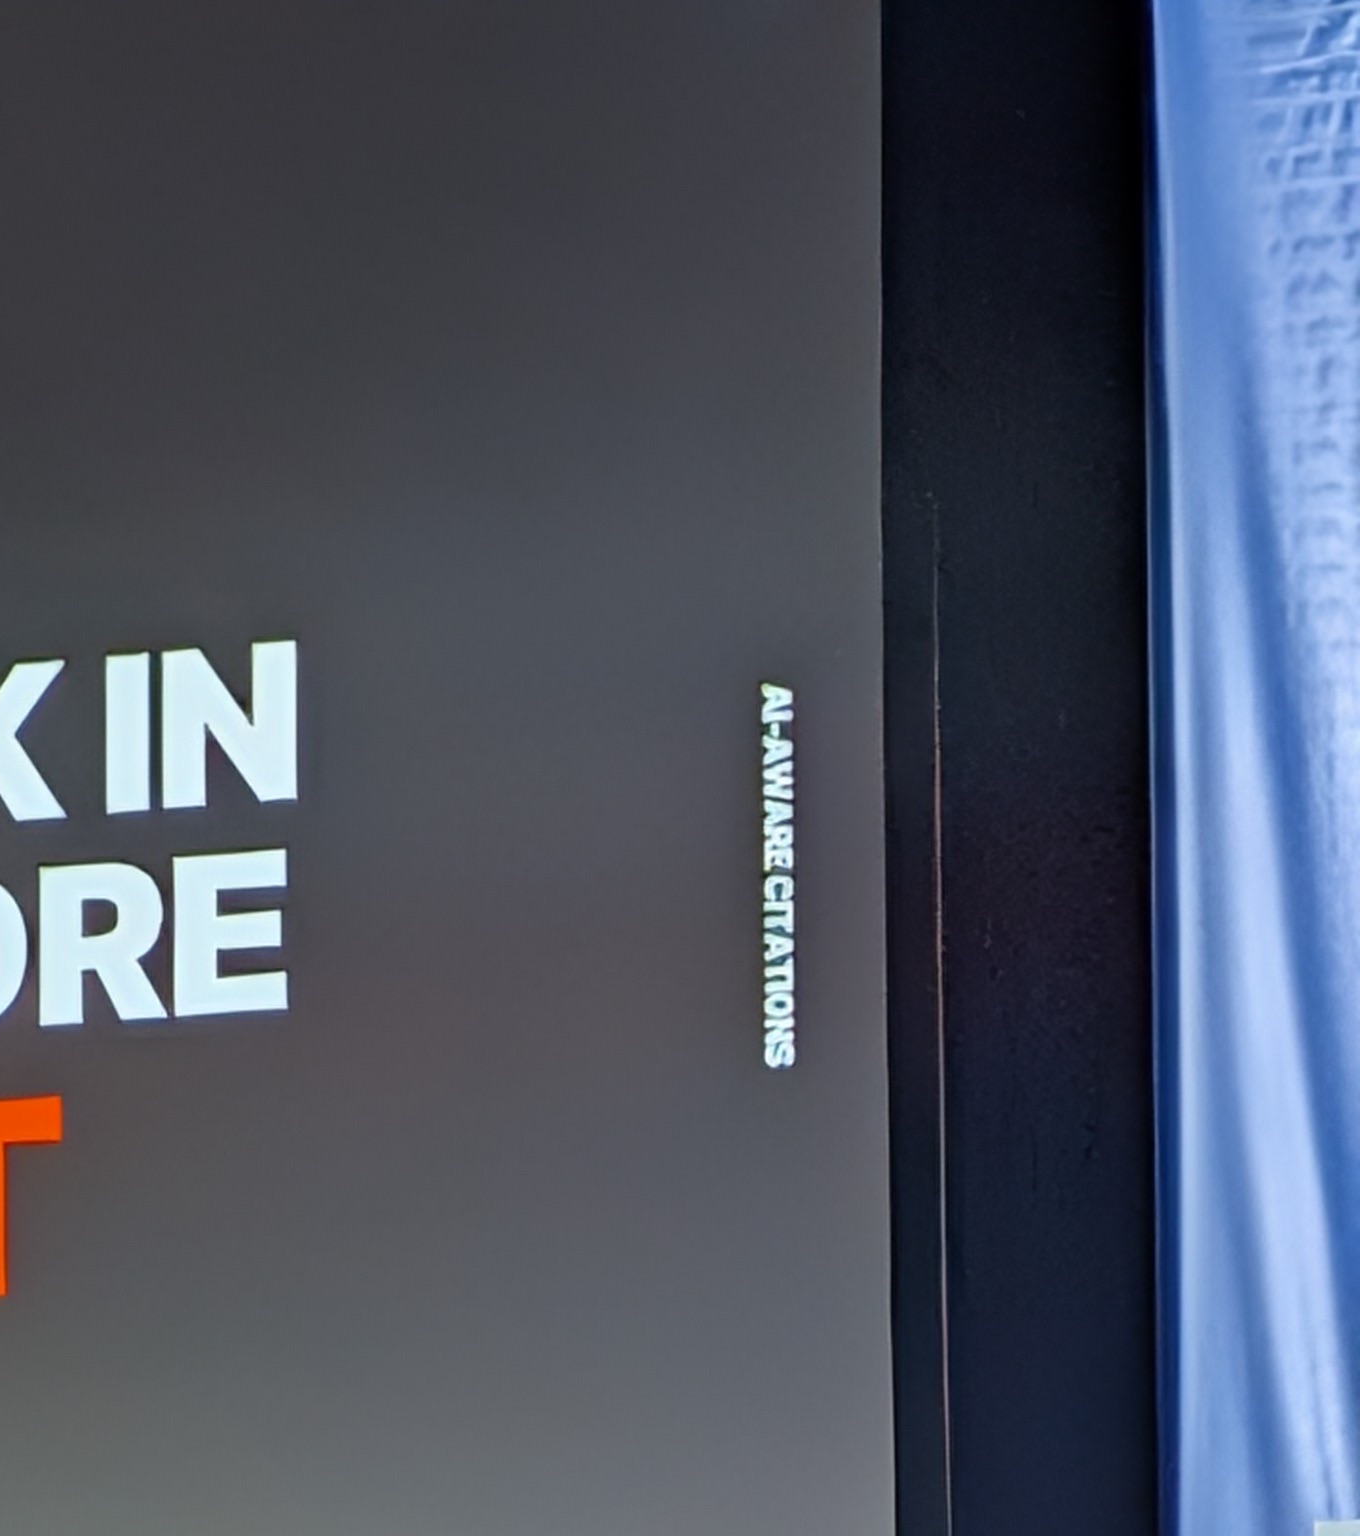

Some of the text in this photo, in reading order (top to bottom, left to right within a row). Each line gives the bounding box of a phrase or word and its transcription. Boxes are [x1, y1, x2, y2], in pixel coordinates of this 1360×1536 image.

[104, 640, 298, 816] IN
[761, 683, 796, 1069] AI-AWARE CITATIONS
